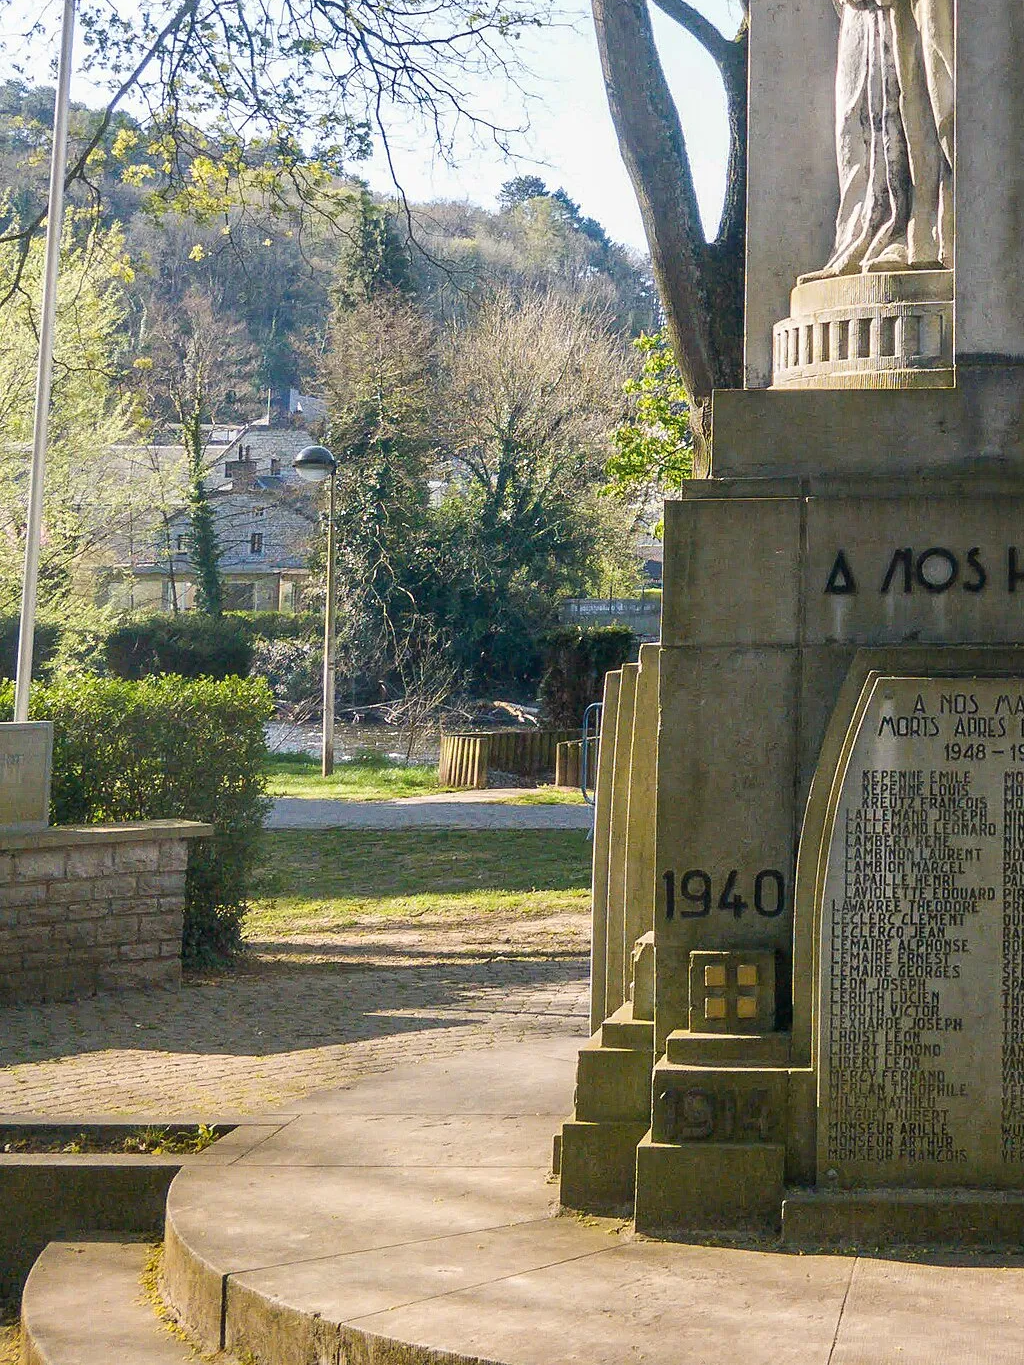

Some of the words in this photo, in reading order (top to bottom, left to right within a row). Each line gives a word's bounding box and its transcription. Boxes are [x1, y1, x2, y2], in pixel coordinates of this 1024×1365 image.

[824, 548, 856, 593] A
[881, 547, 988, 592] NOS
[913, 695, 926, 713] A
[940, 694, 979, 714] NOS
[878, 716, 939, 737] MORTS
[954, 717, 1006, 738] APRES
[944, 744, 986, 761] 1948
[862, 770, 924, 783] KEPENNE
[930, 770, 970, 783] EMILE
[862, 784, 924, 796] KEPENNE
[930, 784, 969, 796] LOUIS
[862, 797, 915, 809] KREUTZ
[847, 810, 927, 822] LALLEMAND
[934, 810, 987, 822] JOSEPH
[846, 823, 928, 835] LALLEMAND
[934, 823, 996, 835] LEONARD
[846, 835, 908, 847] LAMBERT
[916, 835, 949, 847] RENE
[845, 848, 914, 861] LAMBINON
[920, 849, 982, 861] LAURENT
[845, 861, 905, 873] LAMBION
[911, 861, 965, 873] MARCEL
[845, 874, 909, 886] LAPAILLE
[915, 874, 954, 886] HENRI
[662, 869, 786, 920] 1940
[845, 887, 927, 899] LAVIOLETTE
[933, 888, 995, 900] EDOUARD
[833, 900, 901, 912] LAWARREE
[909, 900, 979, 913] THEODORE
[832, 913, 895, 925] LECLERC
[902, 913, 965, 925] CLEMENT
[910, 926, 945, 938] JEAN
[831, 939, 892, 951] LEMAIRE
[898, 940, 969, 952] ALPHONSE
[831, 952, 892, 964] LEMAIRE
[898, 952, 948, 964] ERNEST
[831, 965, 892, 977] LEMAIRE
[898, 965, 960, 977] GEORGES
[831, 978, 866, 991] LEON
[873, 978, 925, 991] JOSEPH
[831, 991, 884, 1004] LERUTH
[891, 991, 939, 1004] LUCIEN
[831, 1004, 884, 1016] LERUTH
[891, 1004, 939, 1016] VICTOR
[909, 1018, 963, 1030] JOSEPH
[830, 1031, 878, 1043] LHOIST
[886, 1031, 920, 1043] LEON
[830, 1044, 878, 1056] LIBERT
[886, 1044, 940, 1056] EDMOND
[1002, 1046, 1024, 1058] VAN
[830, 1057, 878, 1069] LIBERT
[885, 1057, 920, 1069] LEON
[1002, 1059, 1024, 1071] VAN
[830, 1070, 876, 1082] MERCY
[883, 1070, 944, 1082] FERNAND
[1002, 1071, 1024, 1084] VAN
[892, 1083, 967, 1095] THEOPHILE
[878, 1096, 935, 1108] MATHIEU
[829, 1121, 893, 1135] MONSEUR
[900, 1121, 948, 1135] ARILLE
[828, 1135, 893, 1148] MONSEUR
[900, 1136, 953, 1148] ARTHUR
[828, 1149, 893, 1161] MONSEUR
